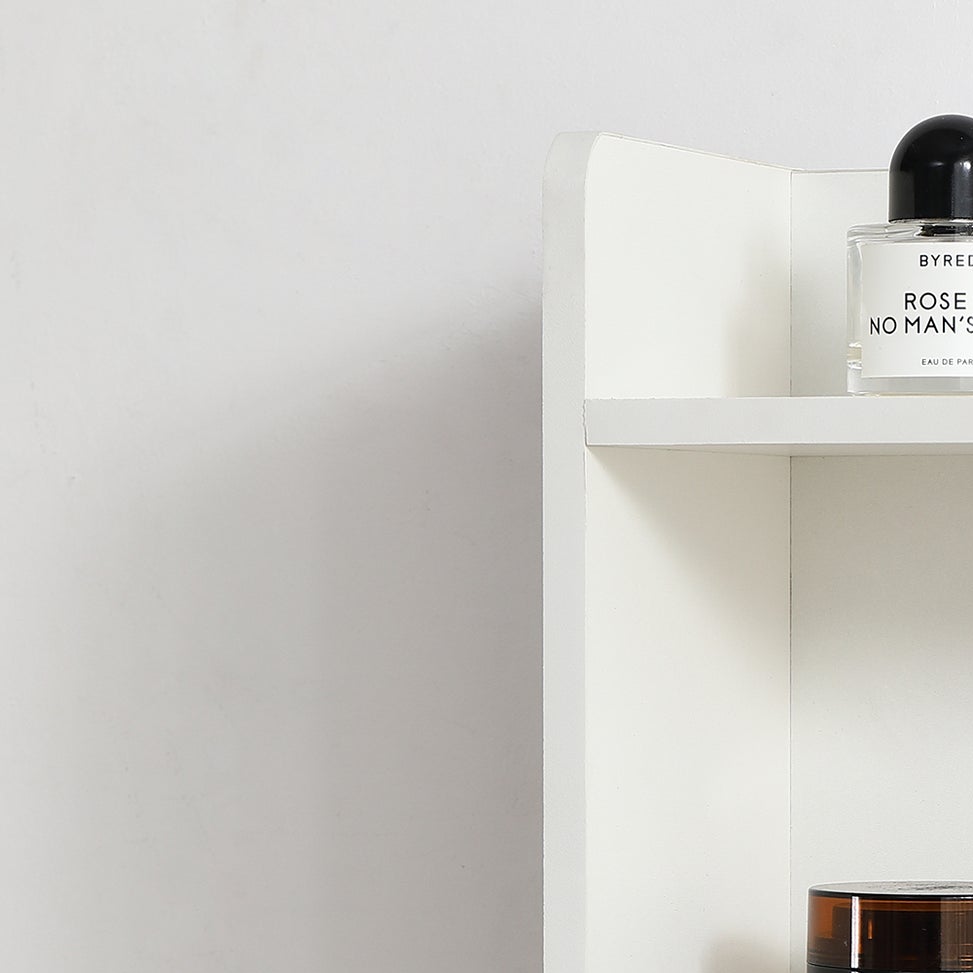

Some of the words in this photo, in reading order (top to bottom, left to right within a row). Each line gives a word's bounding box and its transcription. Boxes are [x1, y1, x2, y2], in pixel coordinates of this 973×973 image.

[904, 292, 967, 310] ROSE
[869, 316, 897, 335] NO
[921, 358, 939, 366] EAU
[942, 358, 954, 366] DE
